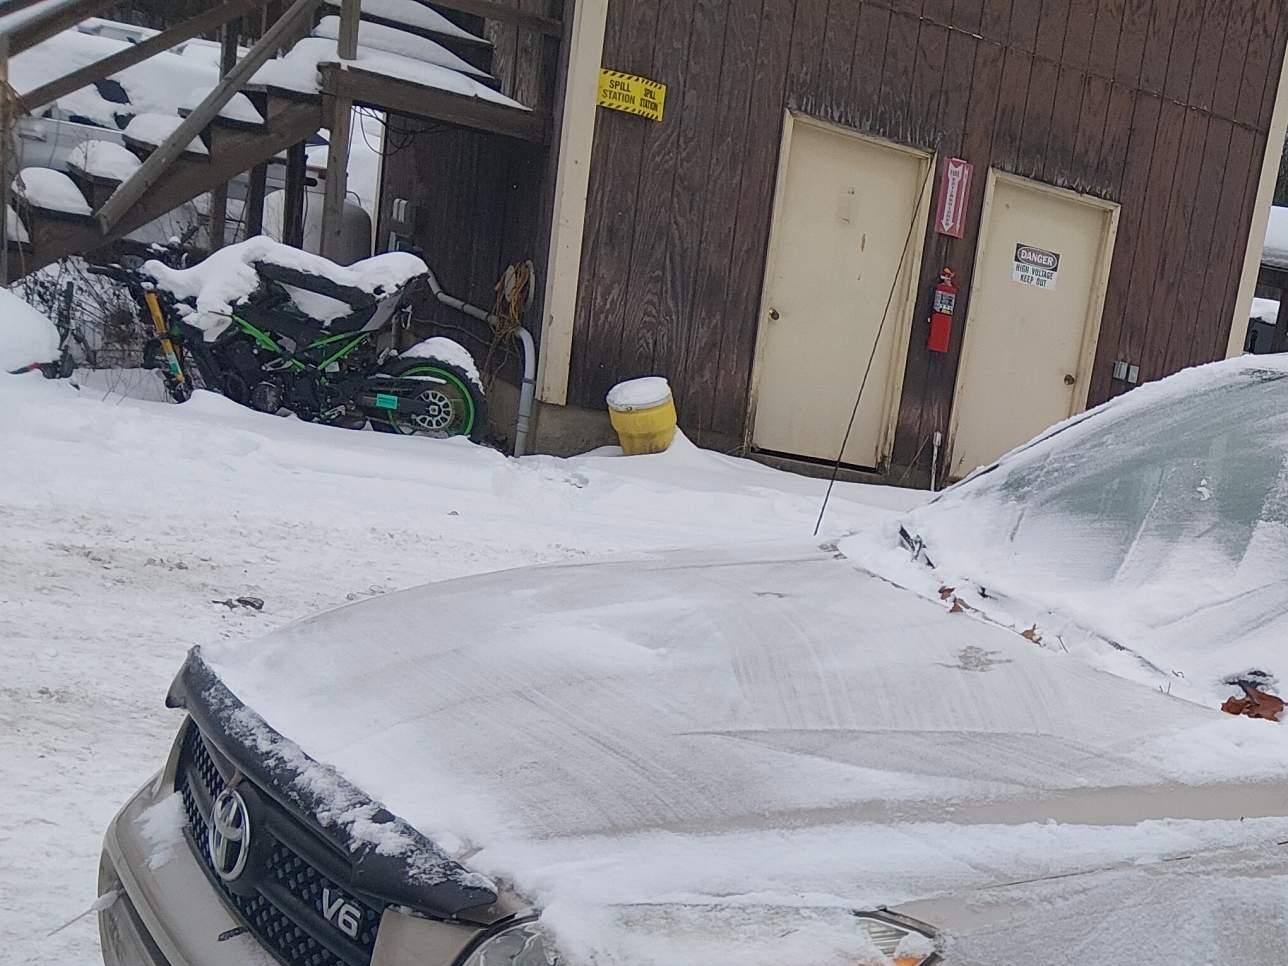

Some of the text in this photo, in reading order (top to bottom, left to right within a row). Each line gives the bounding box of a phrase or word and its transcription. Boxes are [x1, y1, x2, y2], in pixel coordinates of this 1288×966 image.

[609, 80, 631, 92] SPILL
[602, 89, 635, 104] STATION
[643, 88, 656, 100] SPILL
[640, 98, 658, 112] STATION
[1021, 250, 1054, 267] DANGER
[1016, 263, 1054, 280] HIGH VOLTAGE
[1020, 274, 1047, 287] KEEP OUT
[322, 888, 361, 938] V6
